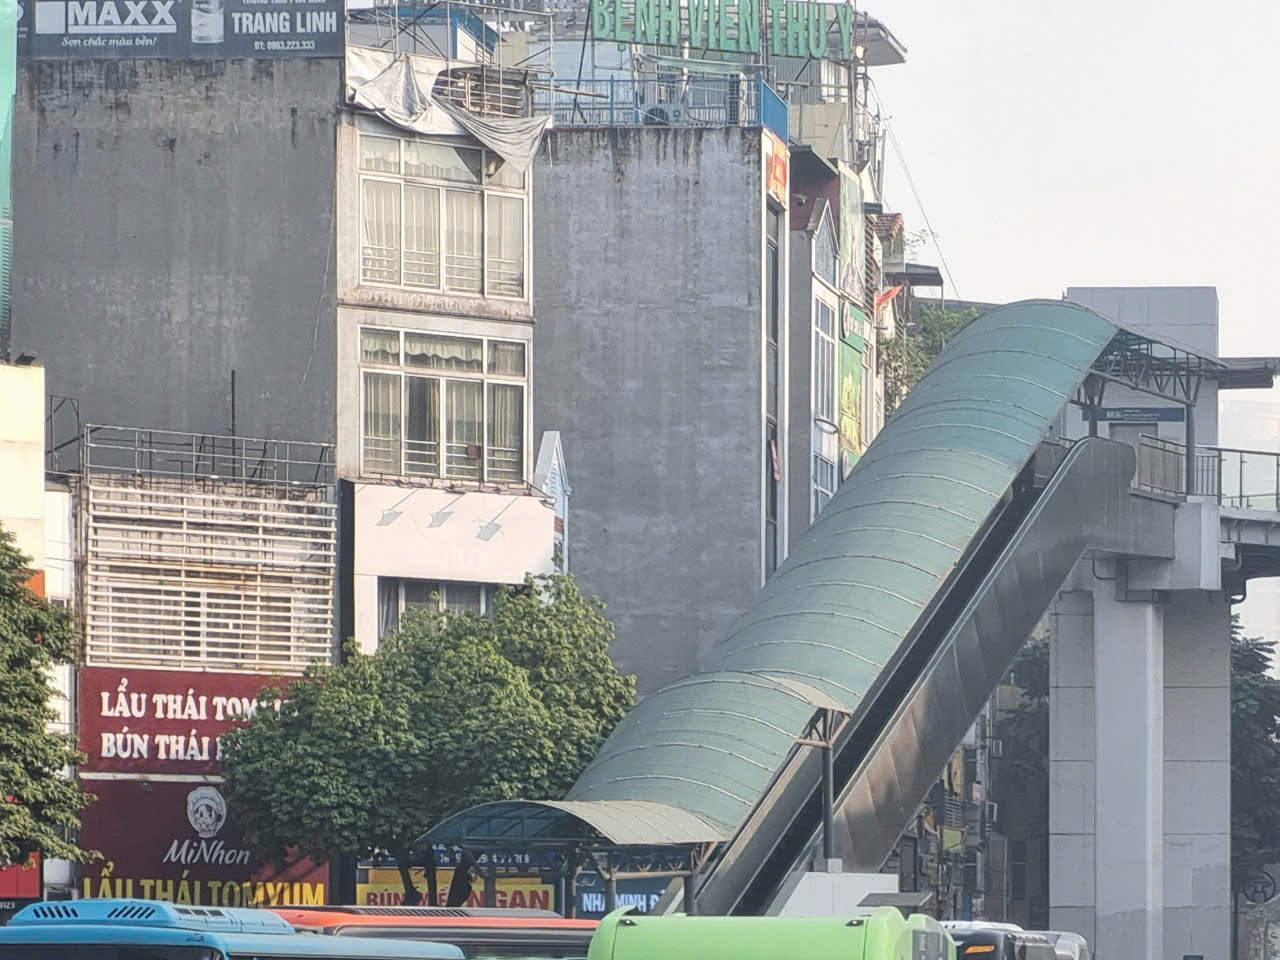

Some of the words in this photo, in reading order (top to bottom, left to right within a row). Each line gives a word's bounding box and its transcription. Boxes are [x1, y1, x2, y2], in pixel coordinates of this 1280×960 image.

[68, 0, 177, 25] MAXX
[231, 12, 290, 34] TRANG
[296, 11, 337, 33] LINH
[835, 4, 853, 60] Y
[101, 677, 147, 719] LẨU
[152, 688, 208, 720] THÁI
[101, 726, 150, 759] BÚN
[155, 728, 210, 761] THÁI
[163, 839, 250, 865] MiNhon
[140, 870, 202, 906] THÁI
[207, 880, 324, 907] TOMYUM
